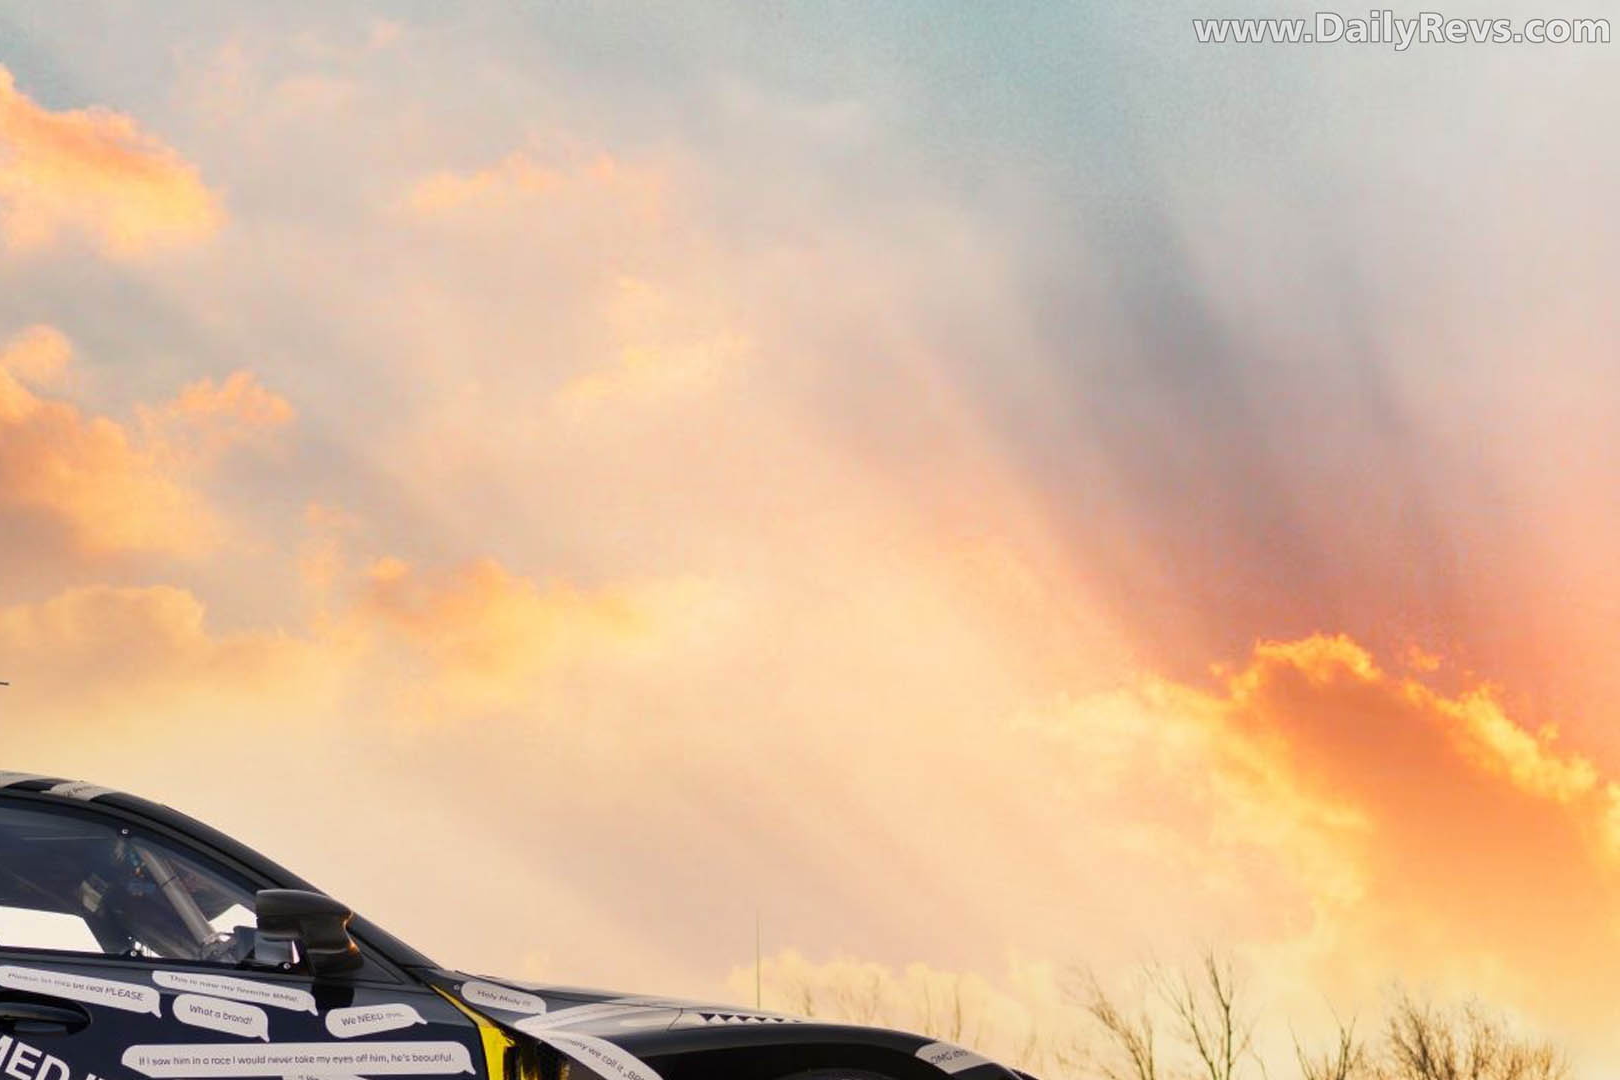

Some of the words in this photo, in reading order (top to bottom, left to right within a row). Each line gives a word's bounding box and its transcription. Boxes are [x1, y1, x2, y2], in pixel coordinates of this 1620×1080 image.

[104, 986, 145, 1001] PLEASE
[190, 1004, 213, 1016] What
[223, 1012, 253, 1025] brand!
[341, 1016, 357, 1026] We
[152, 1057, 171, 1066] saw
[173, 1055, 191, 1065] him
[192, 1056, 201, 1065] in
[202, 1057, 209, 1065] a
[211, 1057, 230, 1065] race
[237, 1054, 266, 1065] would
[268, 1056, 293, 1065] never
[295, 1054, 315, 1064] take
[316, 1055, 330, 1066] my
[332, 1055, 353, 1066] eyes
[356, 1053, 369, 1063] off
[370, 1053, 389, 1064] him,
[391, 1053, 410, 1063] he's
[412, 1052, 454, 1063] beautiful.
